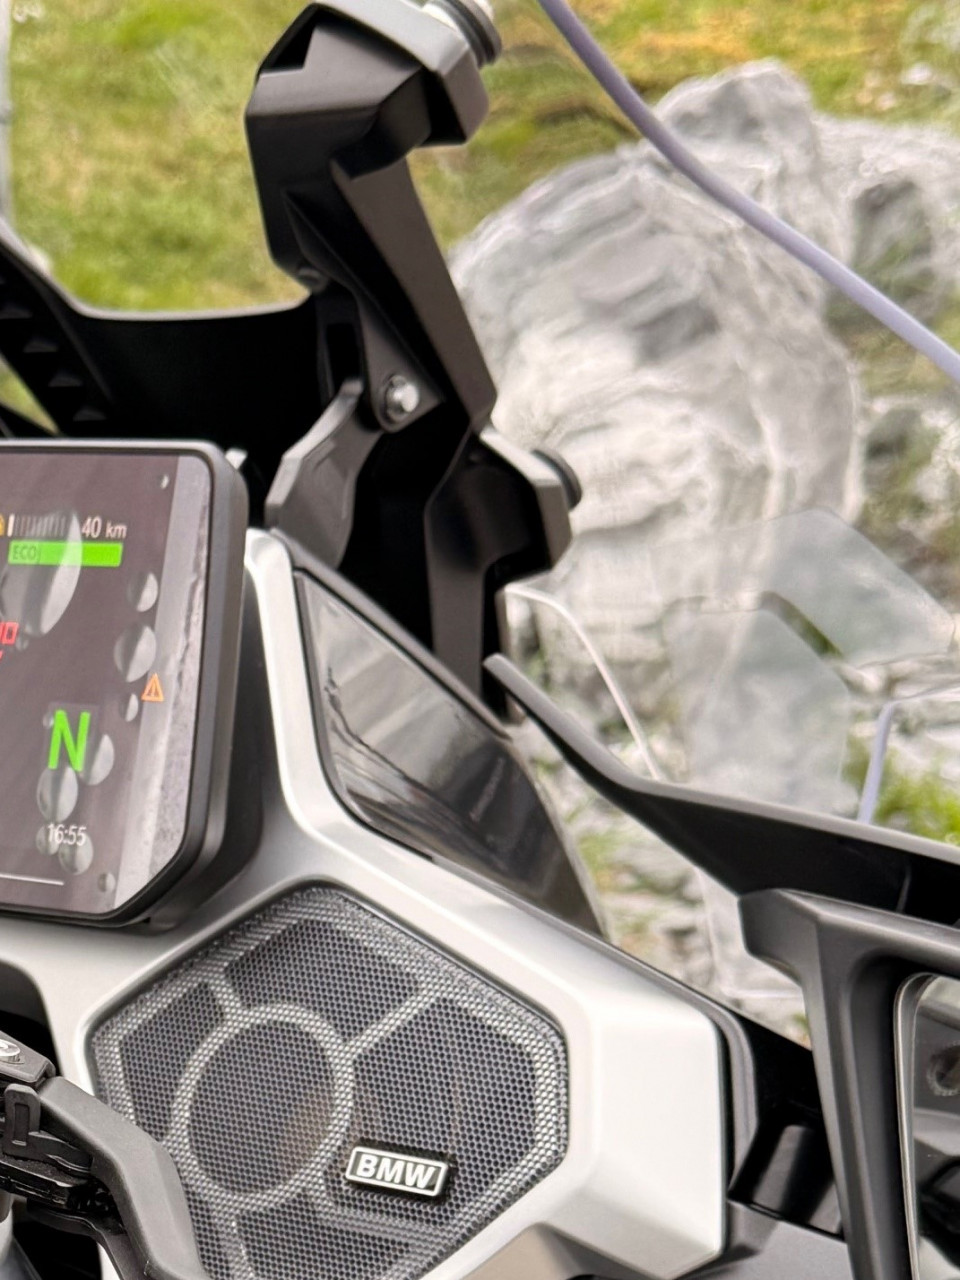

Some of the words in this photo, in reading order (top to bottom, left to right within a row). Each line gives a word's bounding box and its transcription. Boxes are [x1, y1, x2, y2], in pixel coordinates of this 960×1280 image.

[82, 515, 101, 538] 40
[106, 521, 127, 539] km
[12, 545, 38, 561] ECO
[48, 709, 91, 772] N
[47, 823, 87, 846] 16:55
[356, 1154, 436, 1189] BMW
